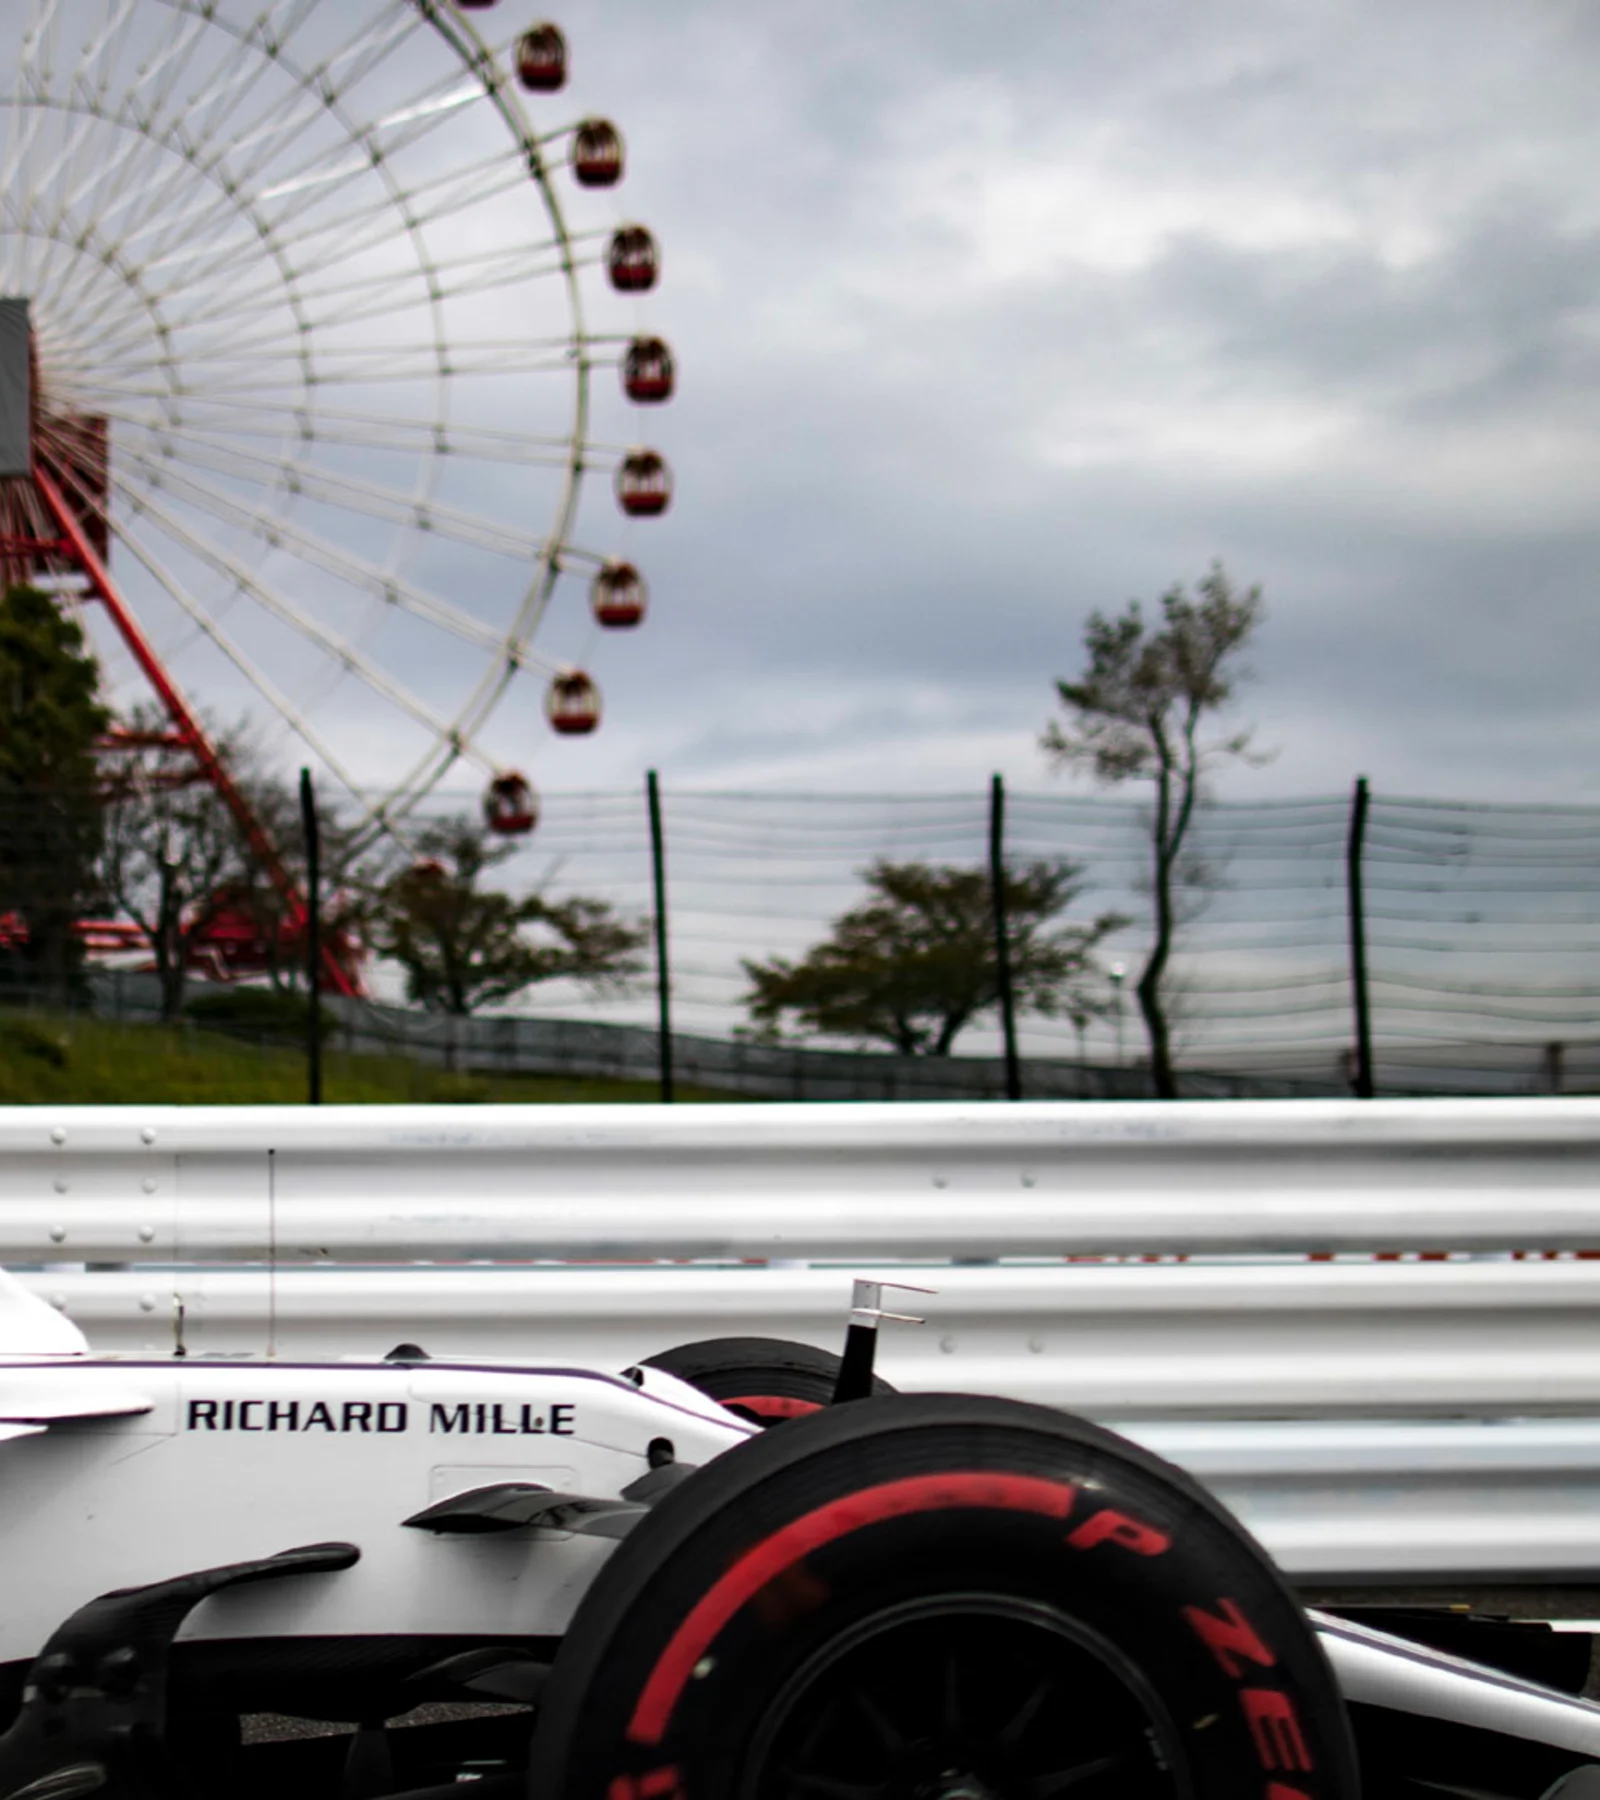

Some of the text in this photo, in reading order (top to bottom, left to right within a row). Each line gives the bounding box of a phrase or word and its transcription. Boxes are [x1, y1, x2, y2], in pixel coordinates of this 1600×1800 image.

[186, 1400, 576, 1434] RICHARD MILLE
[1065, 1508, 1314, 1800] P ZE
